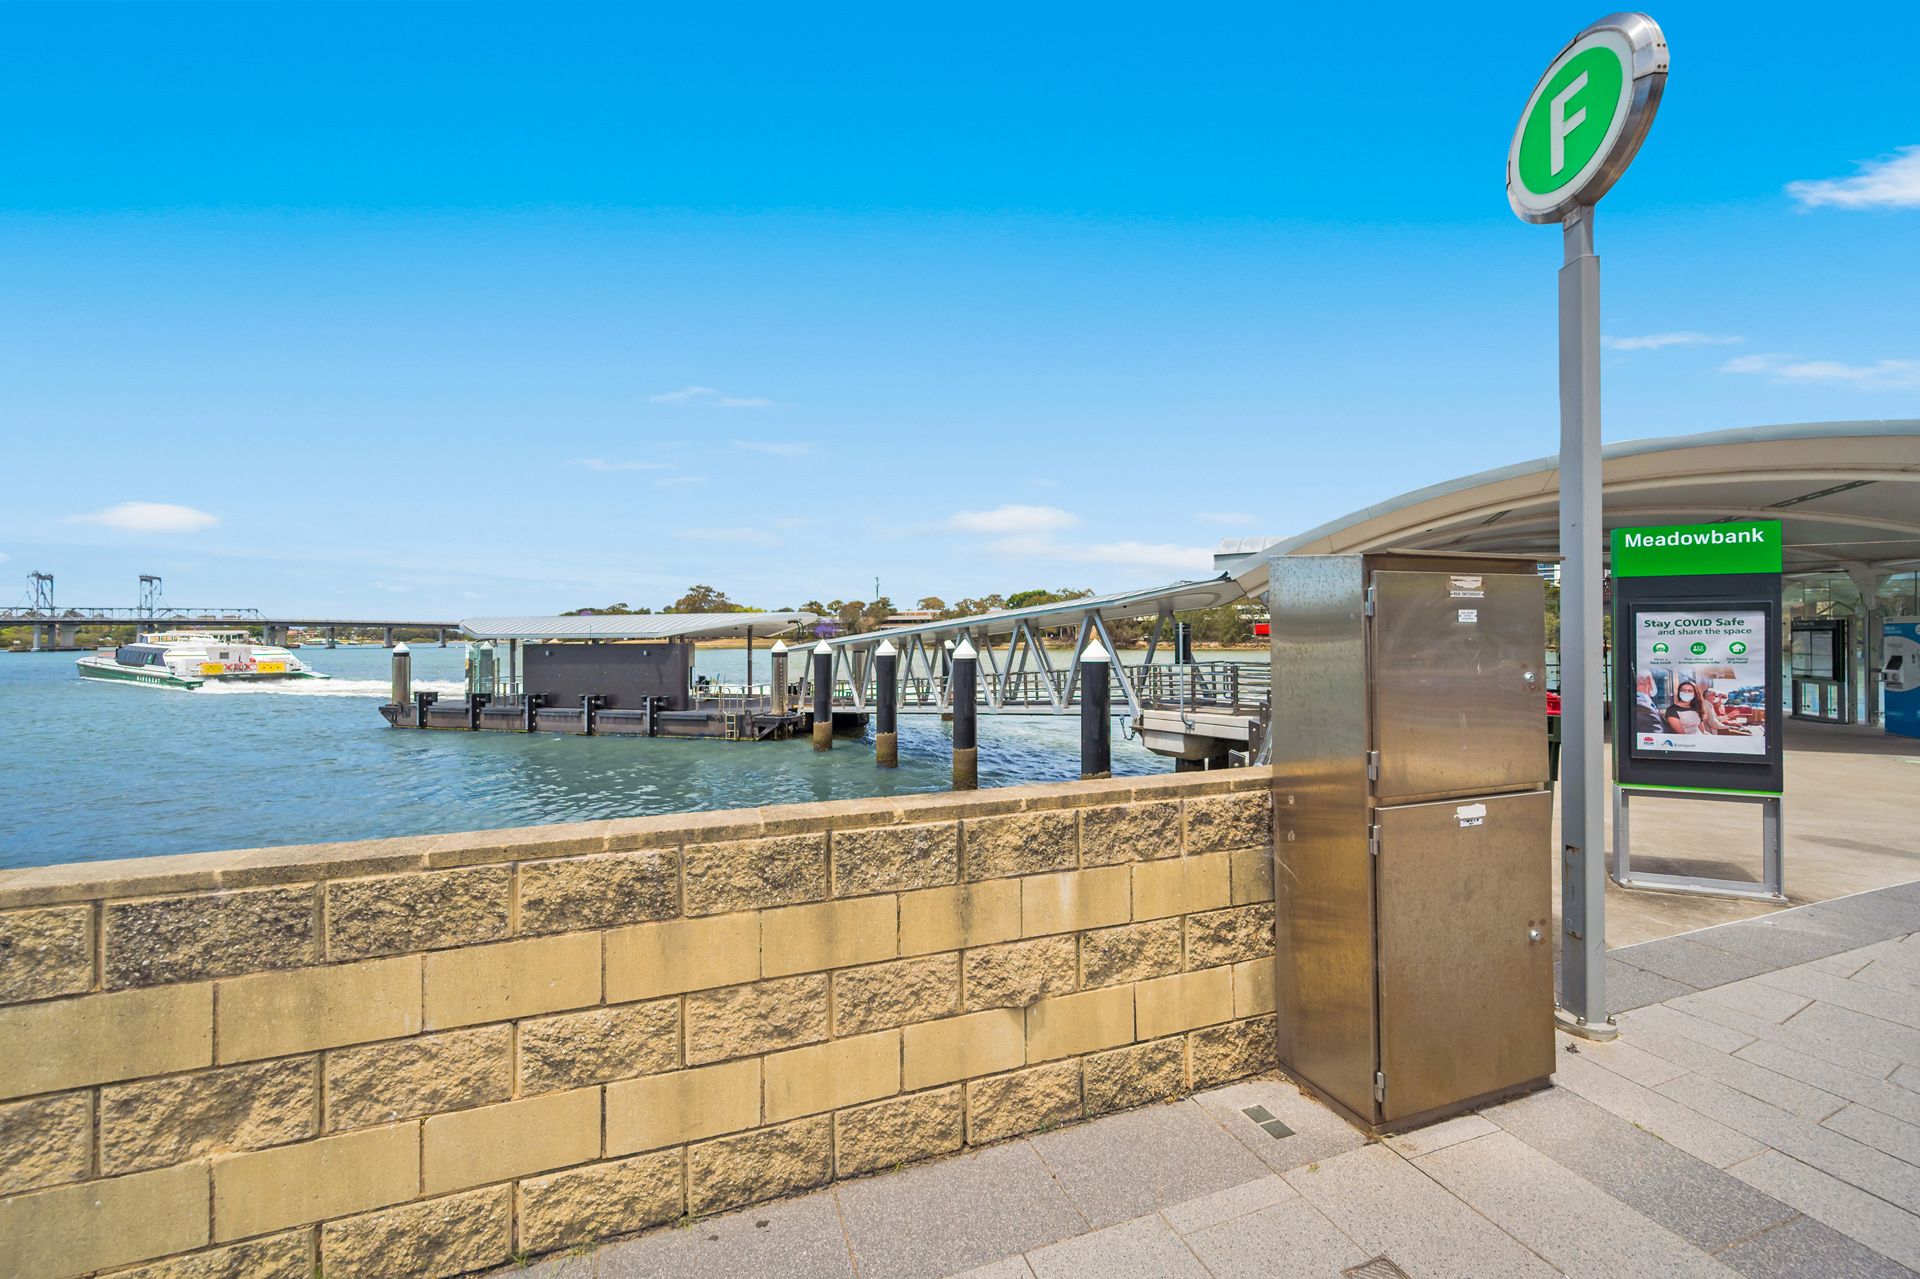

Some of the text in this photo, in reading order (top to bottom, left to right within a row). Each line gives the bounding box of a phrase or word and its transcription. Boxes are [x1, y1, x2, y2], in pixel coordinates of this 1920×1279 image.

[1550, 69, 1589, 177] F
[1624, 527, 1765, 548] Meadowbank
[1644, 617, 1745, 629] Stay COVID Safe
[1657, 628, 1675, 636] and
[1705, 627, 1721, 635] the
[1723, 628, 1752, 636] space
